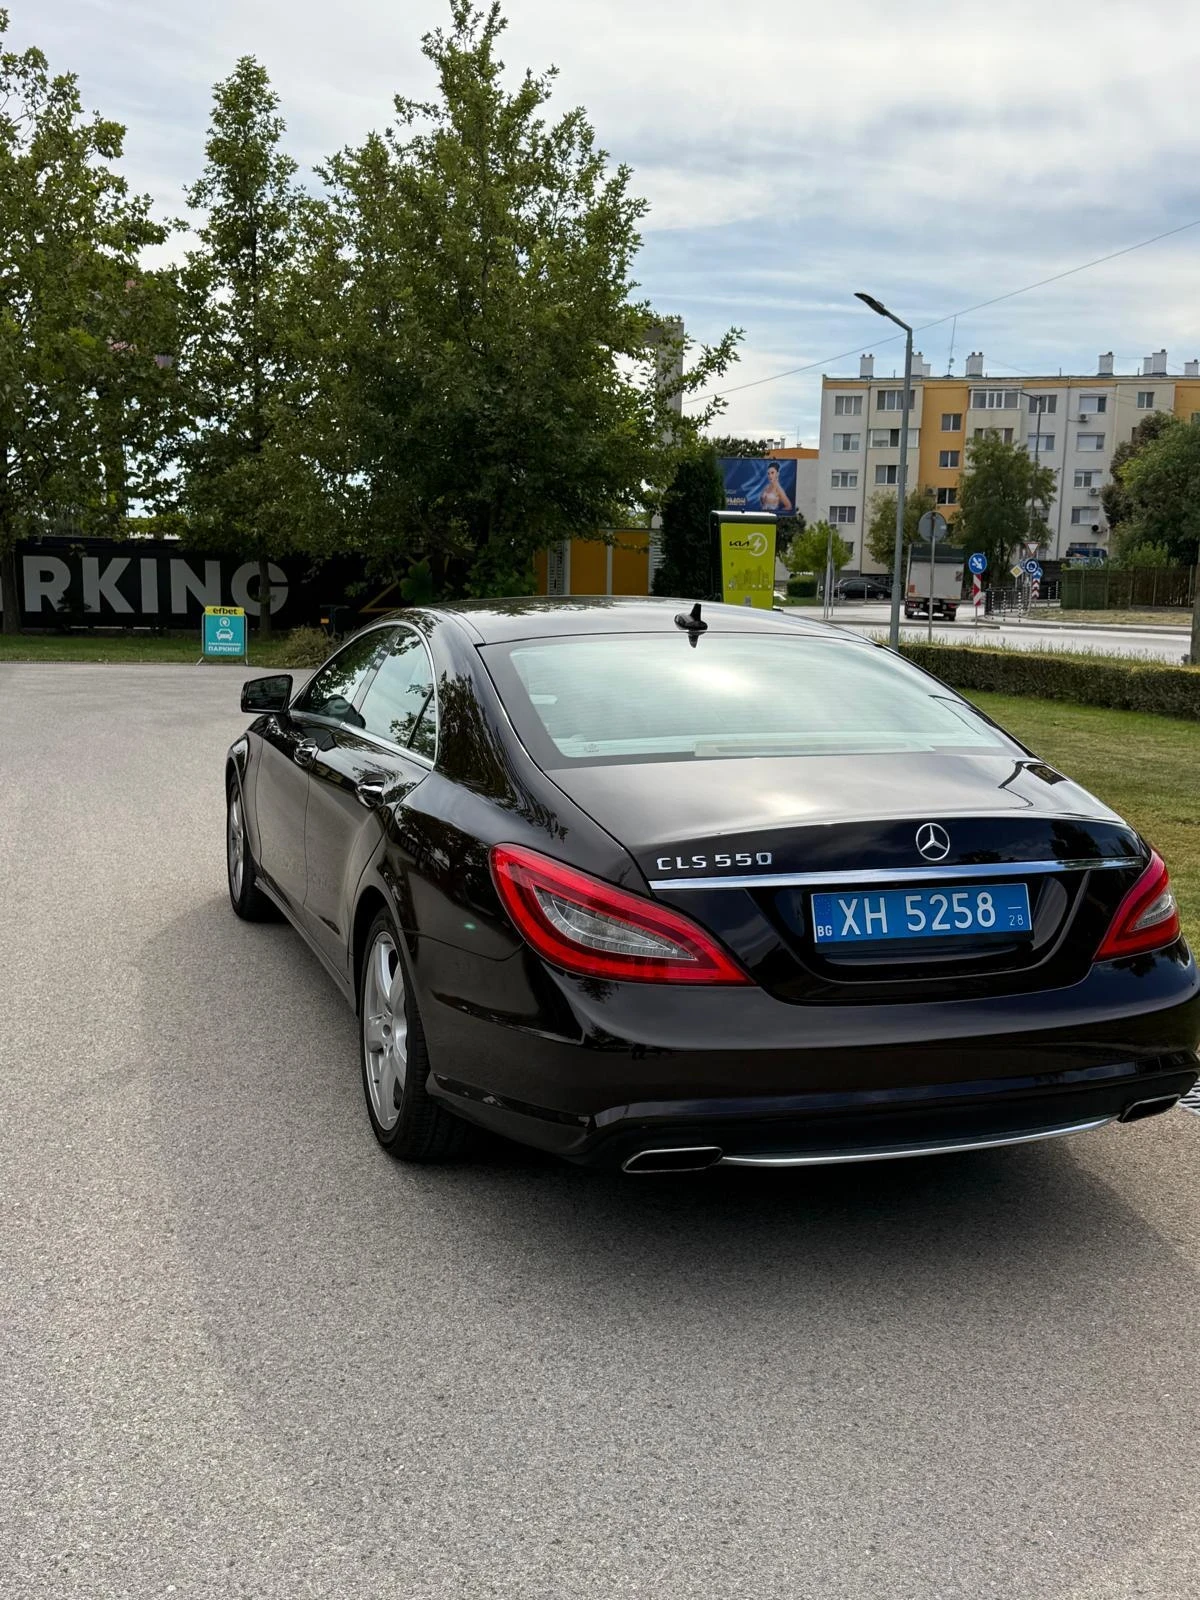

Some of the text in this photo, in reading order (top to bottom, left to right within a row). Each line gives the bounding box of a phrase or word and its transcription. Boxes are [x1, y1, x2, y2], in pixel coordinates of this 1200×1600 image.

[0, 555, 289, 617] RKING
[213, 607, 238, 615] efbet
[656, 852, 773, 871] CLS 550
[816, 892, 1024, 938] BG XH 5258 28
